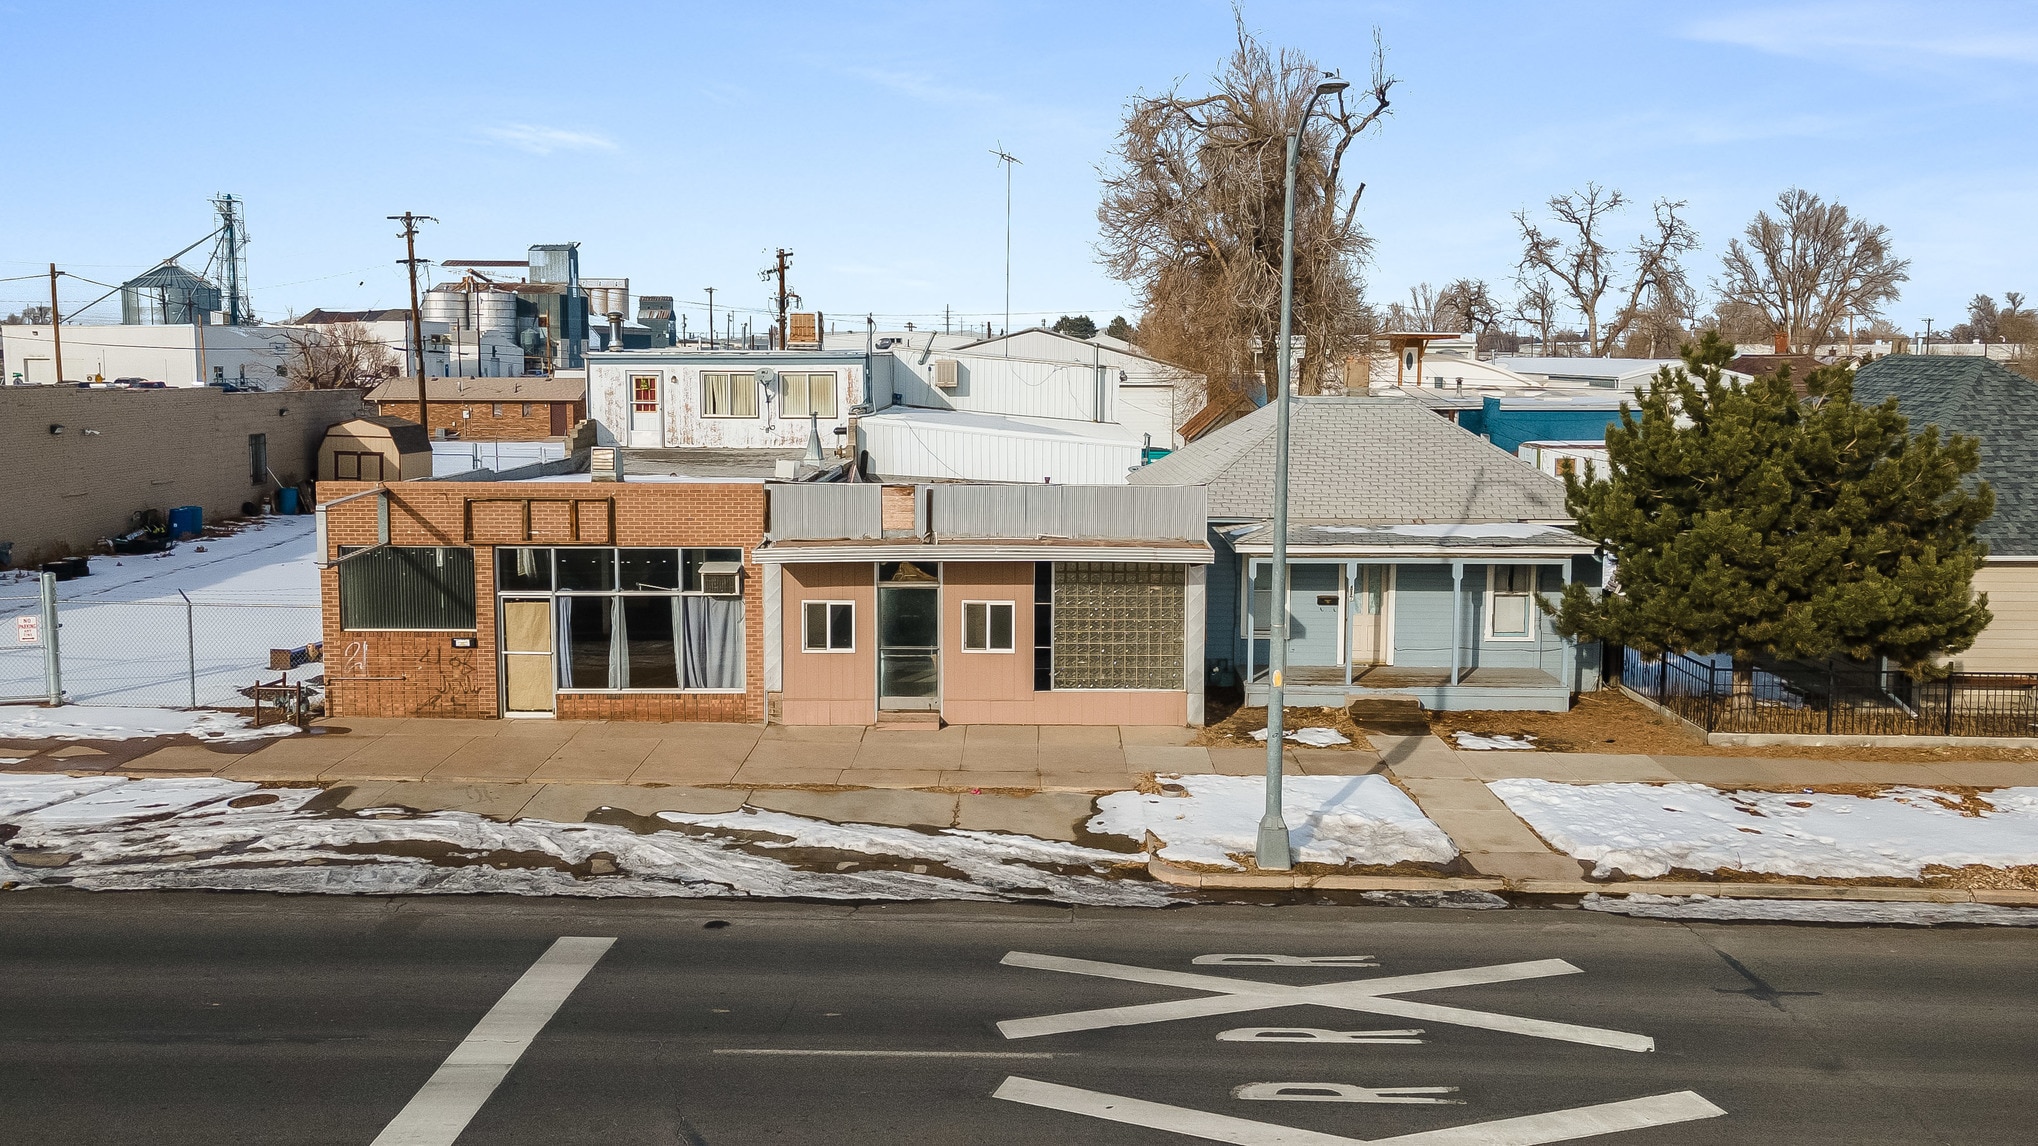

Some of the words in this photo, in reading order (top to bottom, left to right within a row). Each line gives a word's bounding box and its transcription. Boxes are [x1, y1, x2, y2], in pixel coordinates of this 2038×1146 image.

[1192, 954, 1380, 968] R
[1215, 1027, 1428, 1044] R
[1229, 1082, 1467, 1105] R
